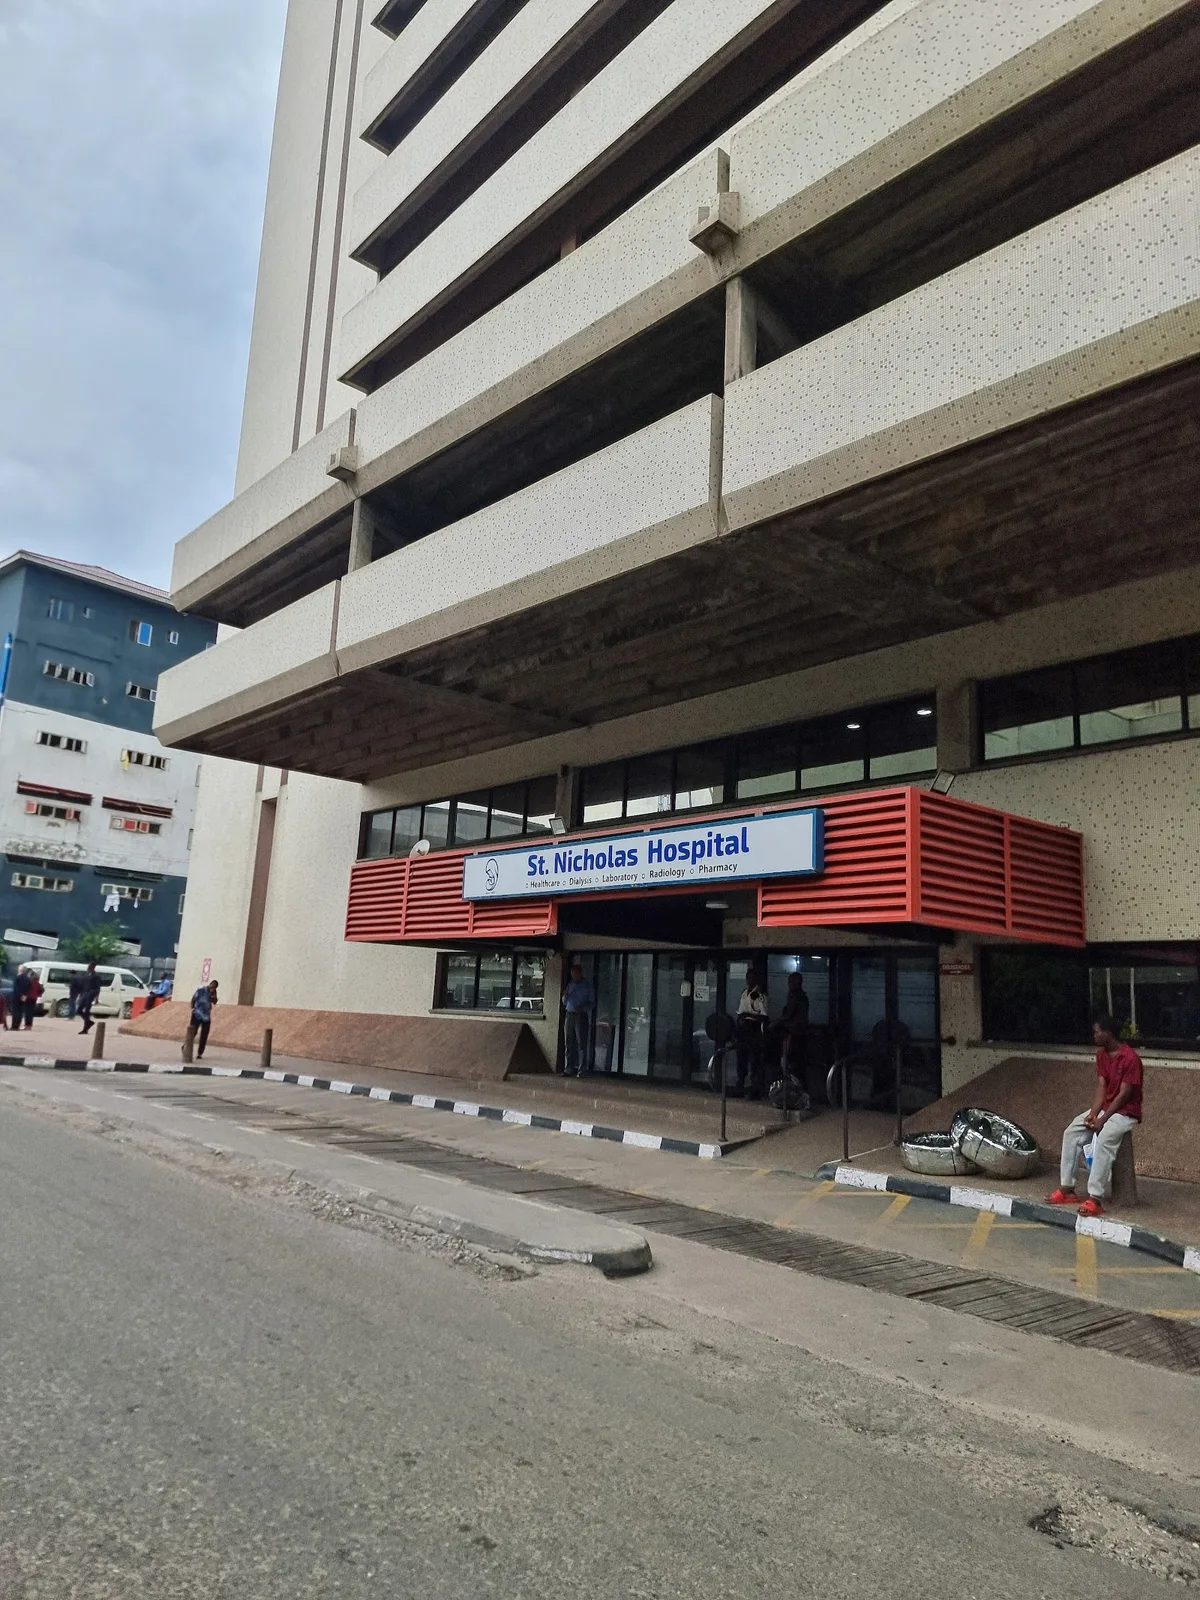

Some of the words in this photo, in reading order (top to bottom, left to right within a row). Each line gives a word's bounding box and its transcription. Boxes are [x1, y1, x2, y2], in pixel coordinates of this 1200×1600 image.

[527, 854, 549, 876] St.
[554, 845, 638, 874] Nicholas
[648, 826, 749, 865] Hospital
[530, 879, 560, 889] Healthcare
[569, 877, 592, 886] Dialysis
[602, 873, 638, 883] Laboratory
[649, 867, 686, 878] Radiology
[698, 863, 738, 874] Pharmacy
